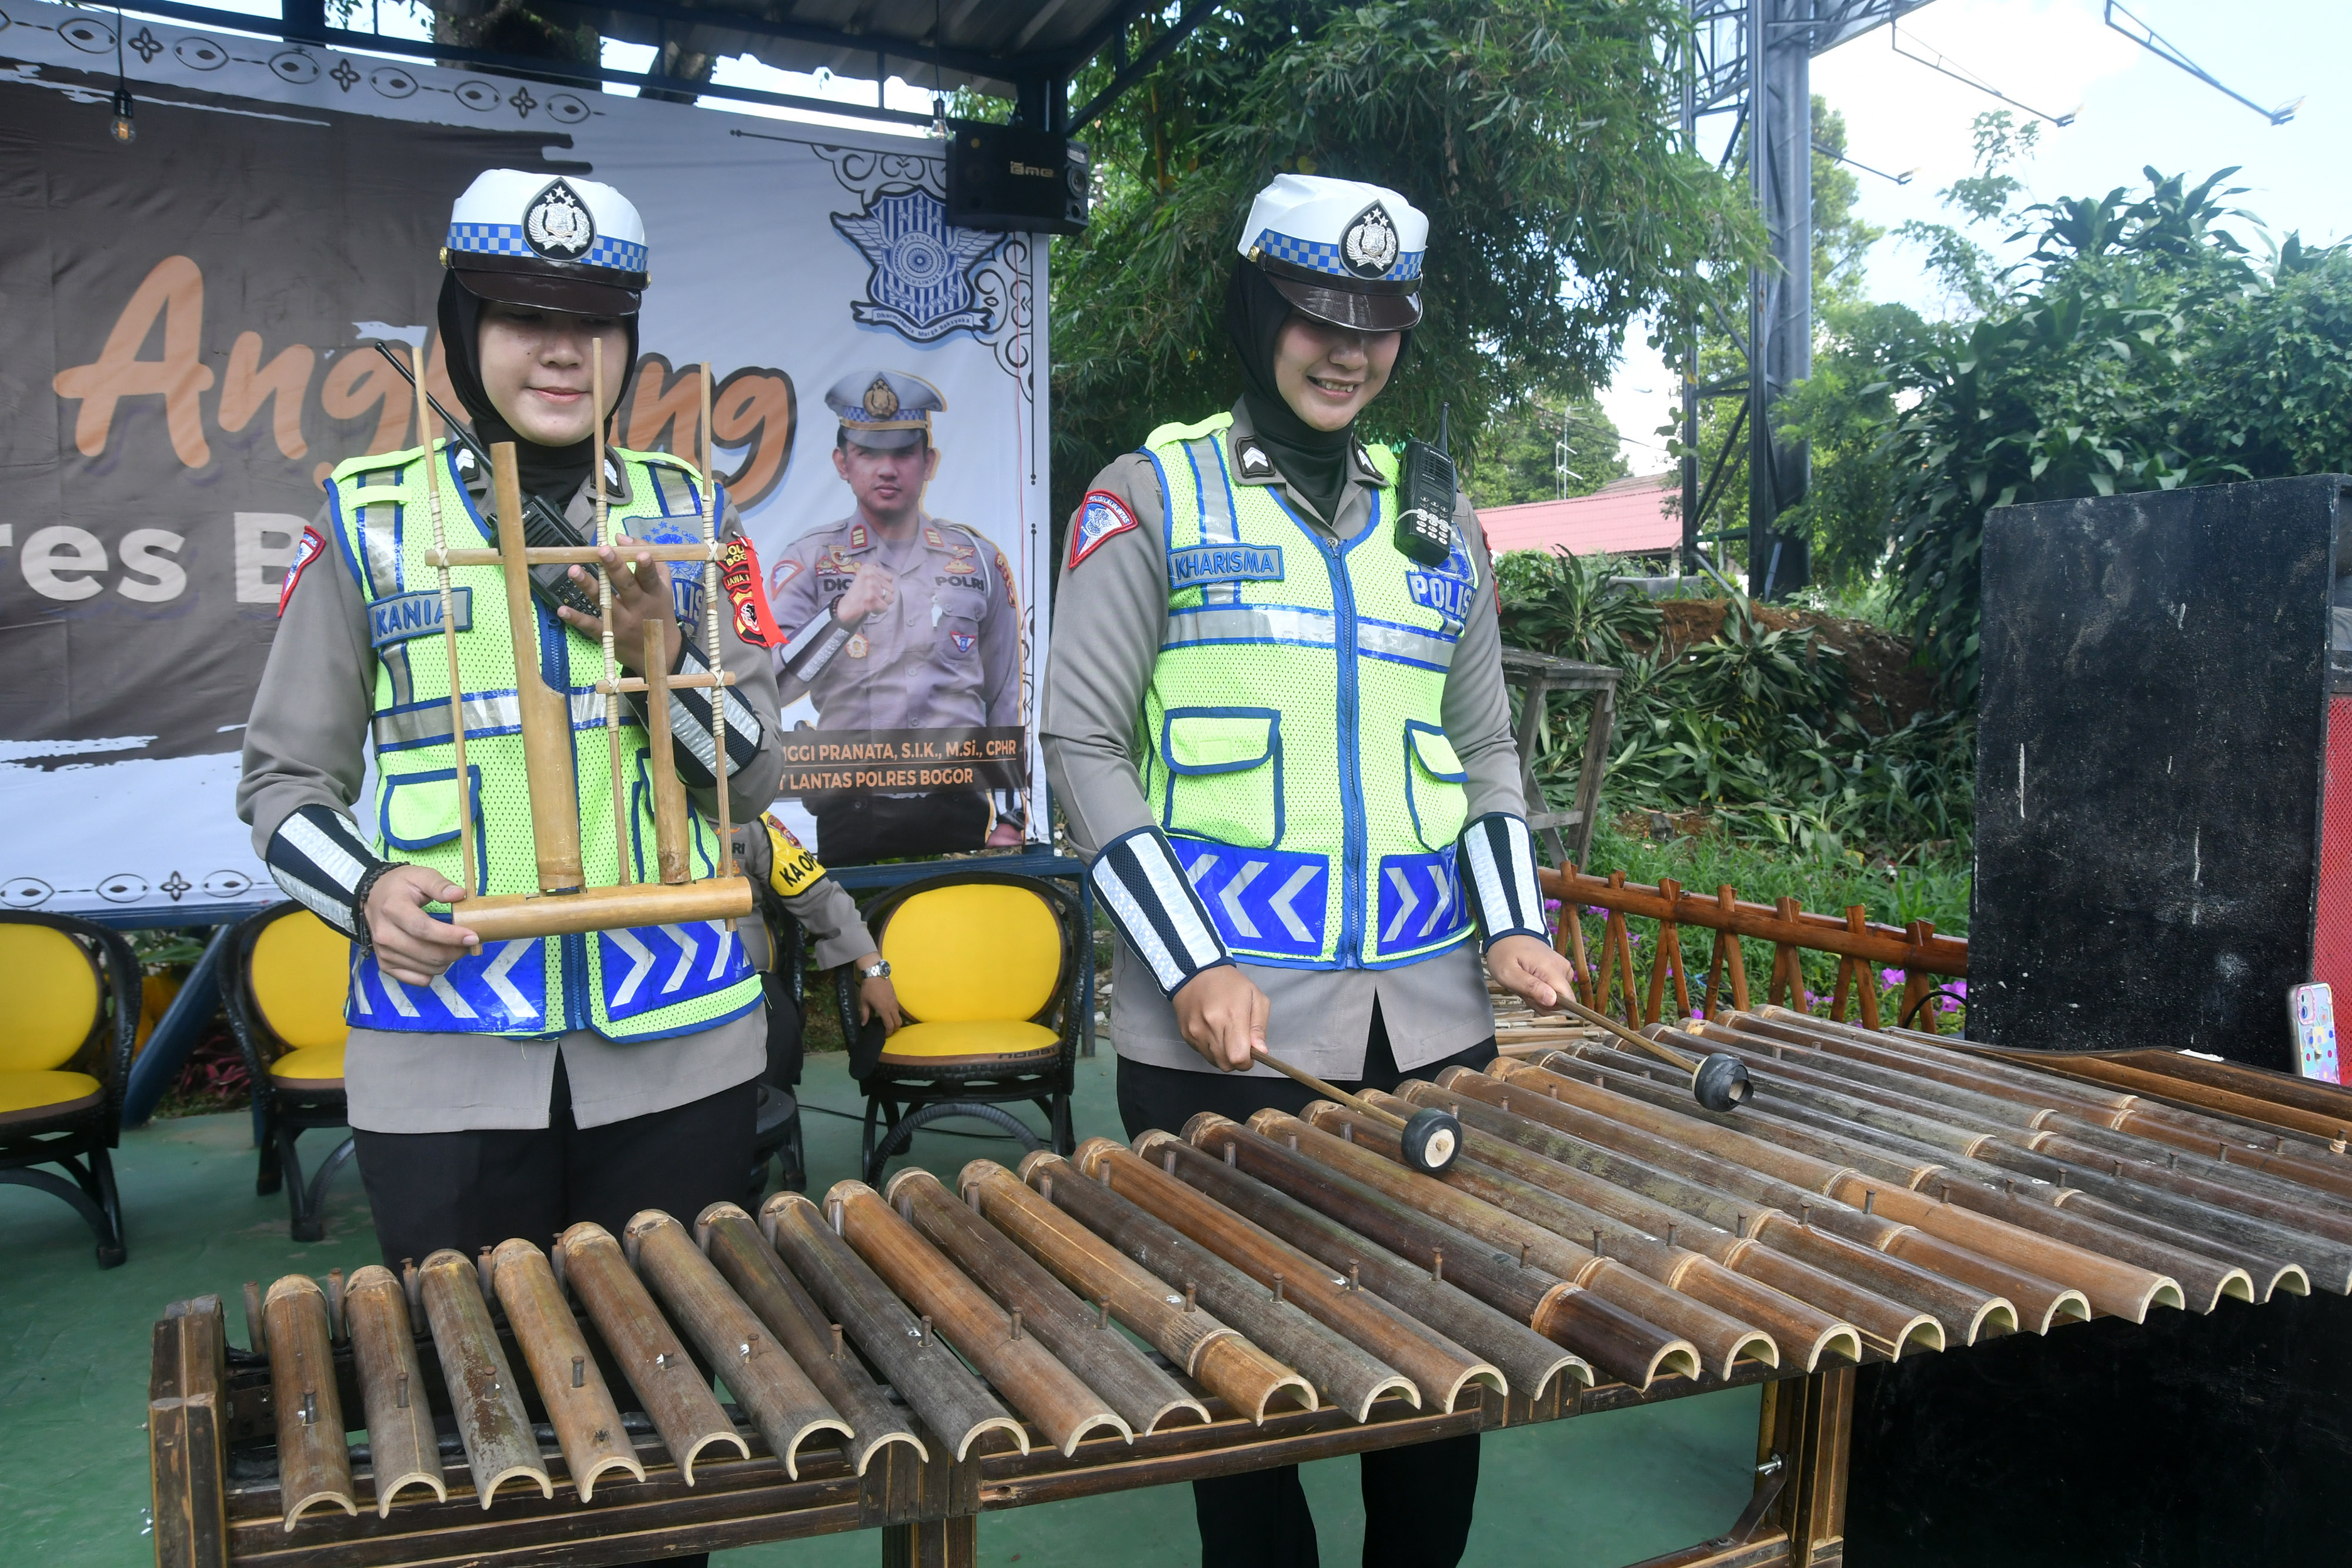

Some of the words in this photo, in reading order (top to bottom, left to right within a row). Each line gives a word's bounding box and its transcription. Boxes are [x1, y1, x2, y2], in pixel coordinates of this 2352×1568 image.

[1429, 450, 1452, 464] MOTOROLA
[1175, 550, 1275, 580] KHARISMA
[935, 576, 984, 591] POLRI
[819, 743, 897, 761] PRANATA,
[901, 742, 942, 760] S.I.K.,
[946, 740, 983, 758] M.Si.,
[986, 740, 1016, 756] CPHR
[790, 772, 852, 790] LANTAS
[856, 770, 916, 788] POLRES
[920, 768, 973, 785] BOGOR
[779, 862, 806, 887] KA
